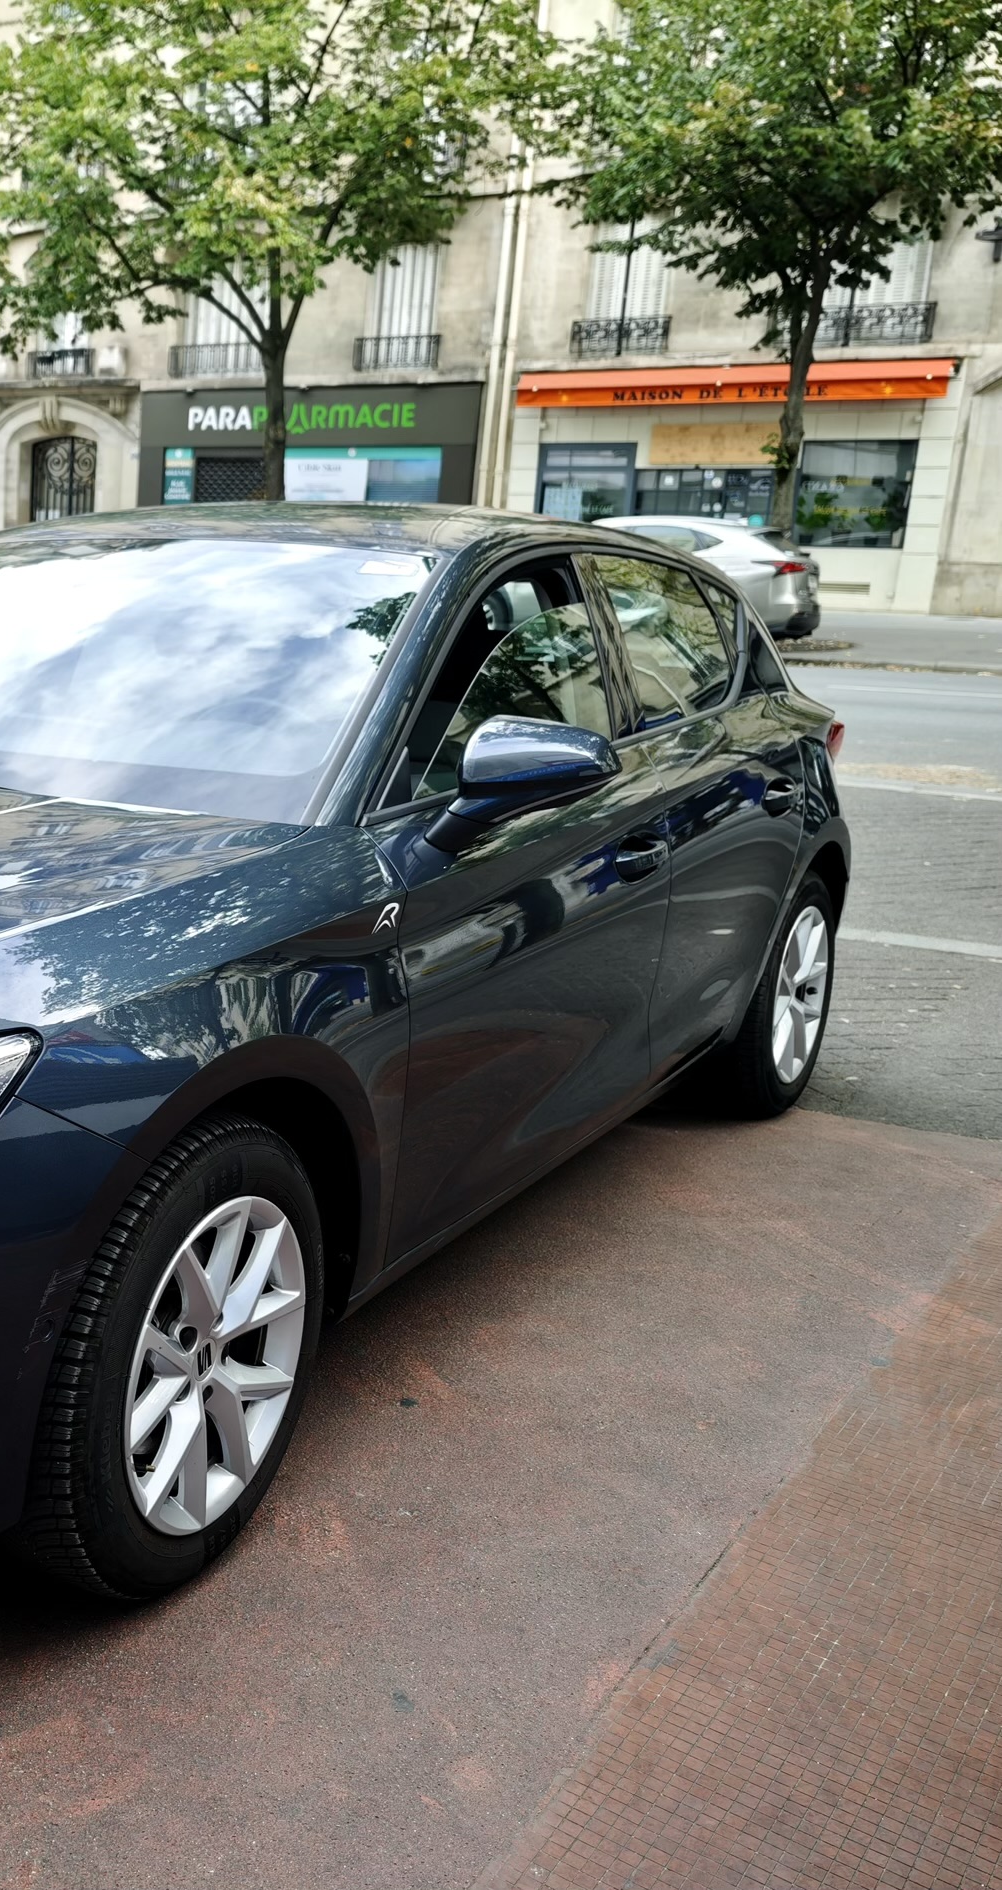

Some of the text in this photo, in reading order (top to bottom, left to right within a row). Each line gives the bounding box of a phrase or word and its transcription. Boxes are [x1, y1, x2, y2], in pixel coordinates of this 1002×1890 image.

[612, 383, 828, 402] MAISON DE L'ÉTLE
[187, 403, 416, 434] PARAPARMACIE
